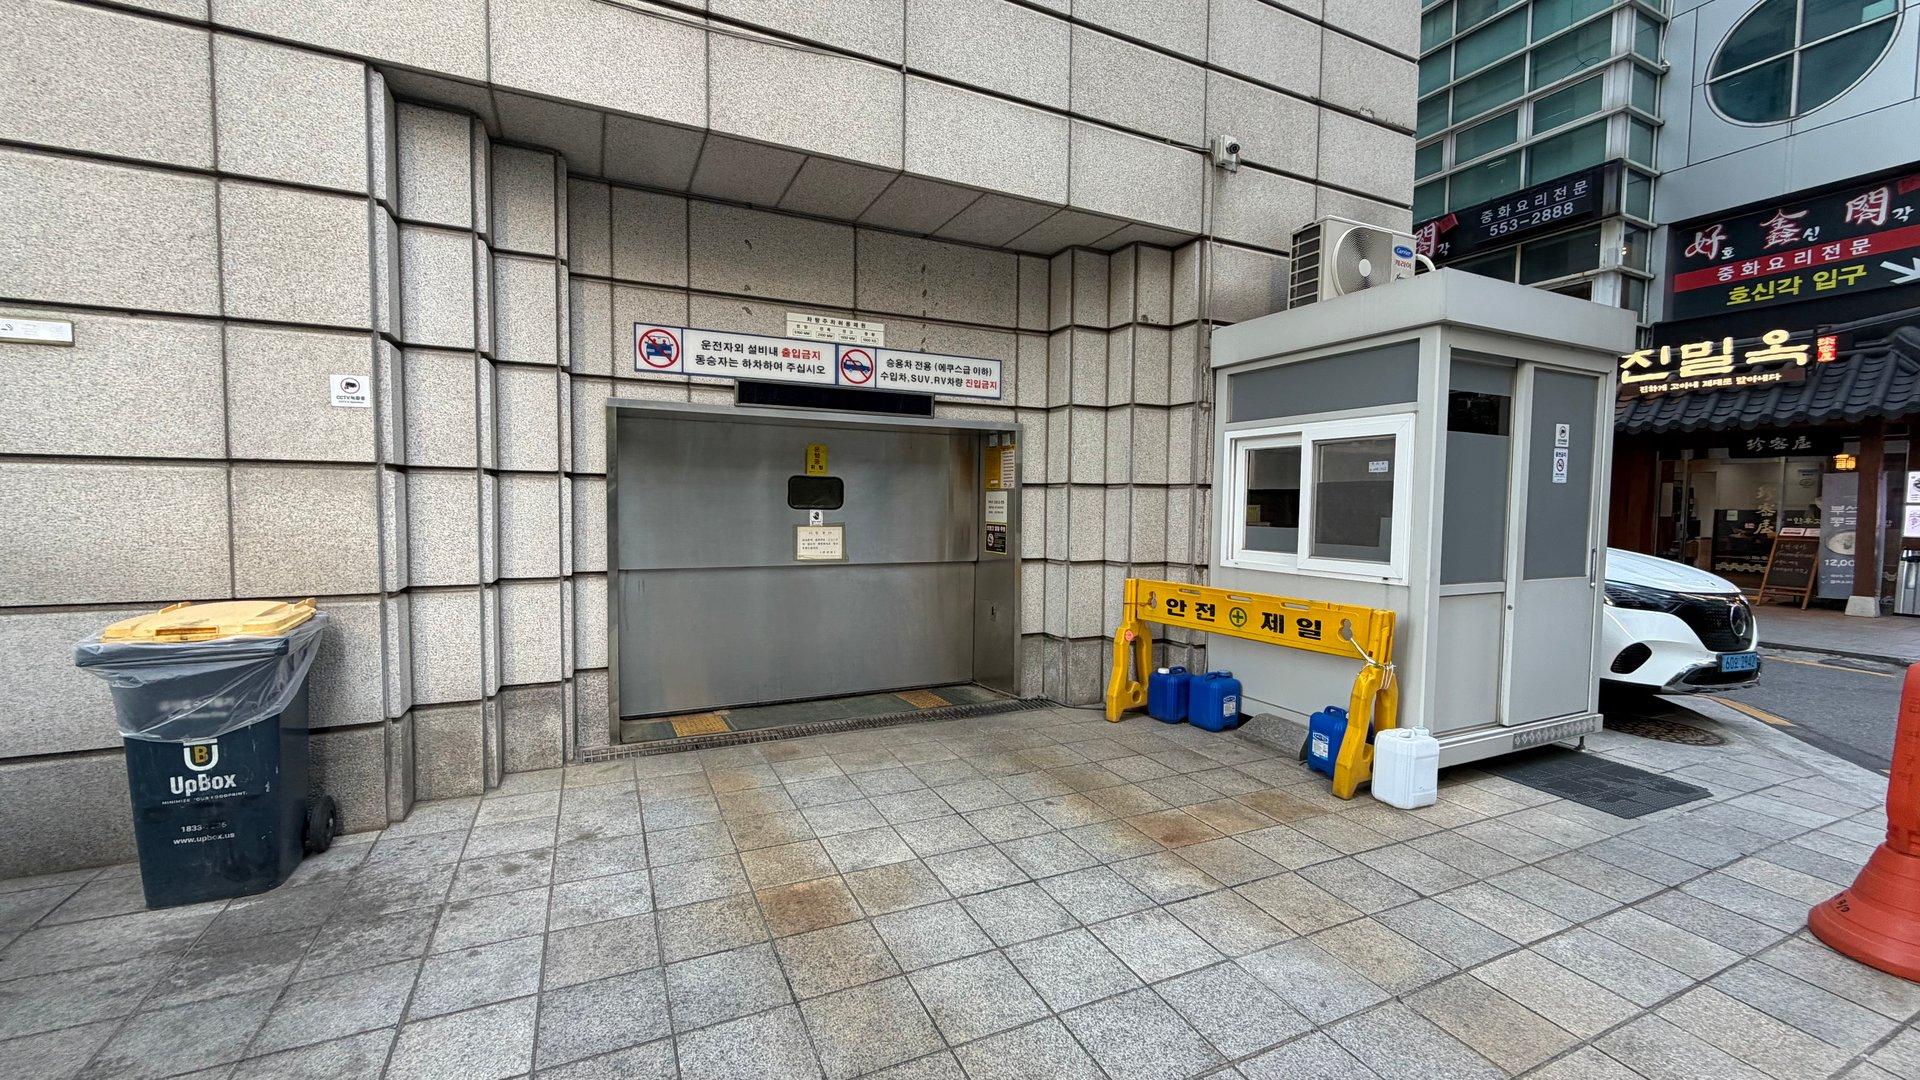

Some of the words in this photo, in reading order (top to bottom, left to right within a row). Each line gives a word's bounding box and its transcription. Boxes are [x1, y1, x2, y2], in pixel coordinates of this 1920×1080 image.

[1480, 181, 1588, 223] 중화요리전문
[1490, 202, 1574, 237] 553-2888
[1684, 224, 1728, 260] 好
[1721, 246, 1736, 260] 호
[1759, 208, 1808, 250] 鑫
[1802, 225, 1821, 242] 신
[1891, 204, 1915, 223] 각
[1716, 238, 1872, 282] 중화요리전문
[1726, 275, 1803, 306] 호신각
[1812, 264, 1868, 292] 입구
[695, 354, 739, 368] 동승자는
[742, 358, 783, 371] 하차하여
[786, 362, 826, 375] 주십시오
[701, 339, 743, 354] 운전자외
[747, 345, 778, 357] 설비내
[781, 347, 821, 360] 출입금지
[1620, 329, 1811, 384] 진밀옥
[886, 358, 912, 369] 승용차
[915, 361, 931, 371] 전용
[934, 363, 971, 375] (에쿠스급
[973, 367, 992, 377] 이하)
[965, 379, 997, 390] 진입금지
[1166, 598, 1216, 622] 안전
[1261, 612, 1322, 641] 제일
[170, 773, 237, 797] UpBox
[173, 832, 235, 845] www.upbox.us
